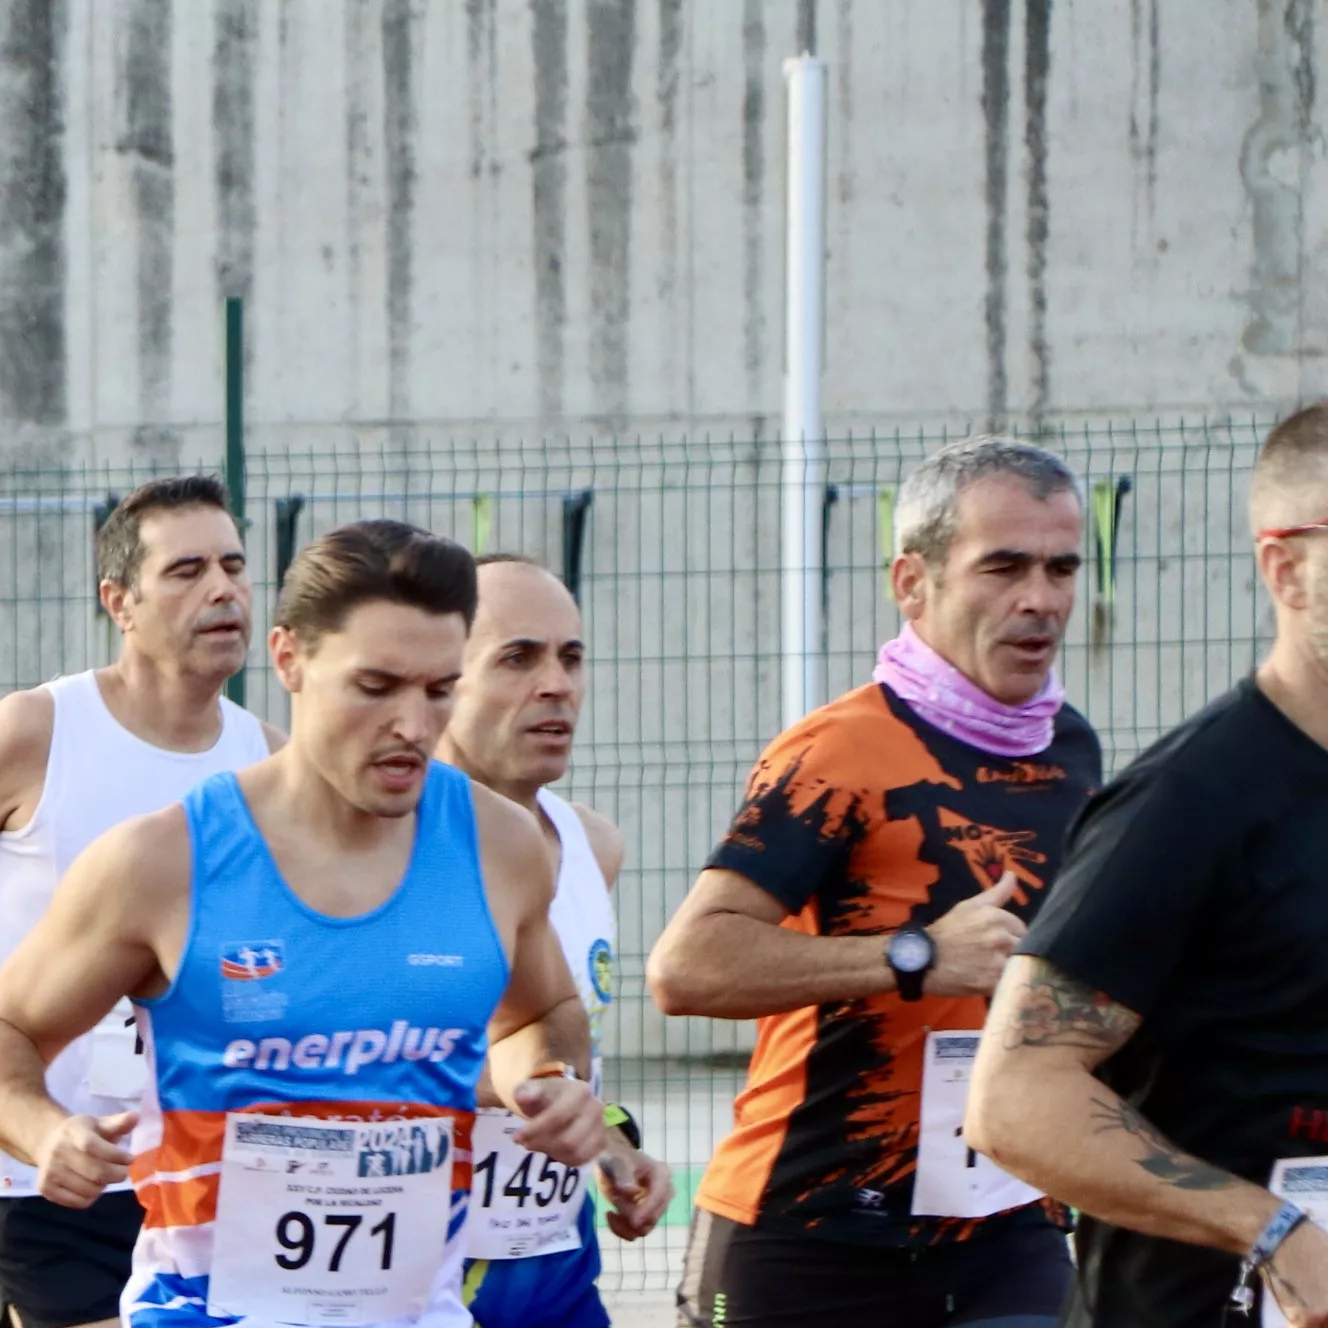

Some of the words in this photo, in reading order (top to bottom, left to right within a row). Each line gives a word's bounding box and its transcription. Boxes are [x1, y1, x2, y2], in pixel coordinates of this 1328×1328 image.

[222, 1019, 467, 1076] enerplus
[358, 1126, 412, 1152] 2024
[474, 1151, 580, 1208] 1456
[274, 1210, 396, 1272] 971
